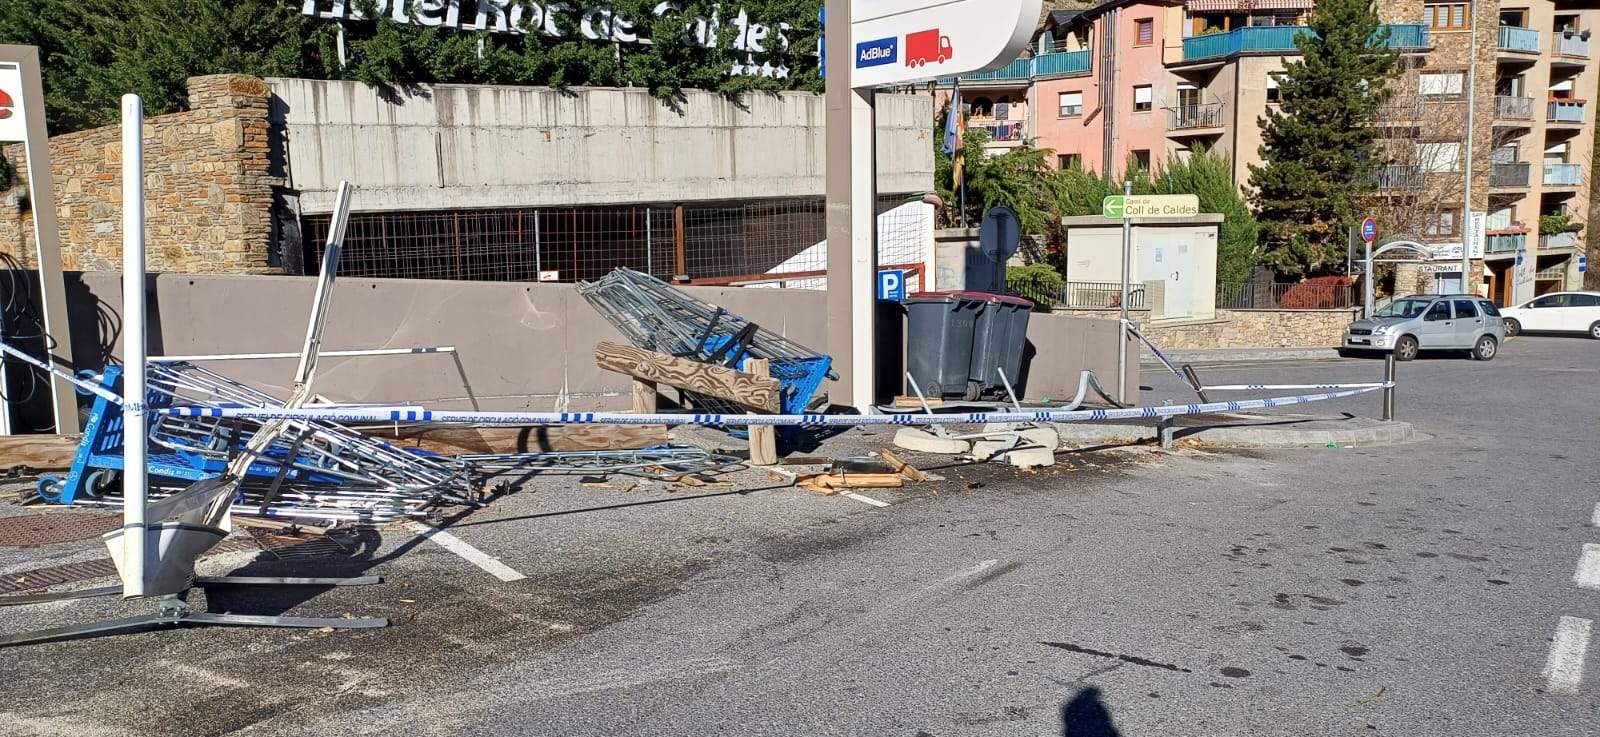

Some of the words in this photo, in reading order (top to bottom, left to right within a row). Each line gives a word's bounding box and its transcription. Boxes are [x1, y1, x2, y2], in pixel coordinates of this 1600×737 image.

[1125, 205, 1144, 215] Coll
[1147, 205, 1160, 215] de
[1162, 204, 1197, 215] Caldes
[883, 273, 899, 299] P
